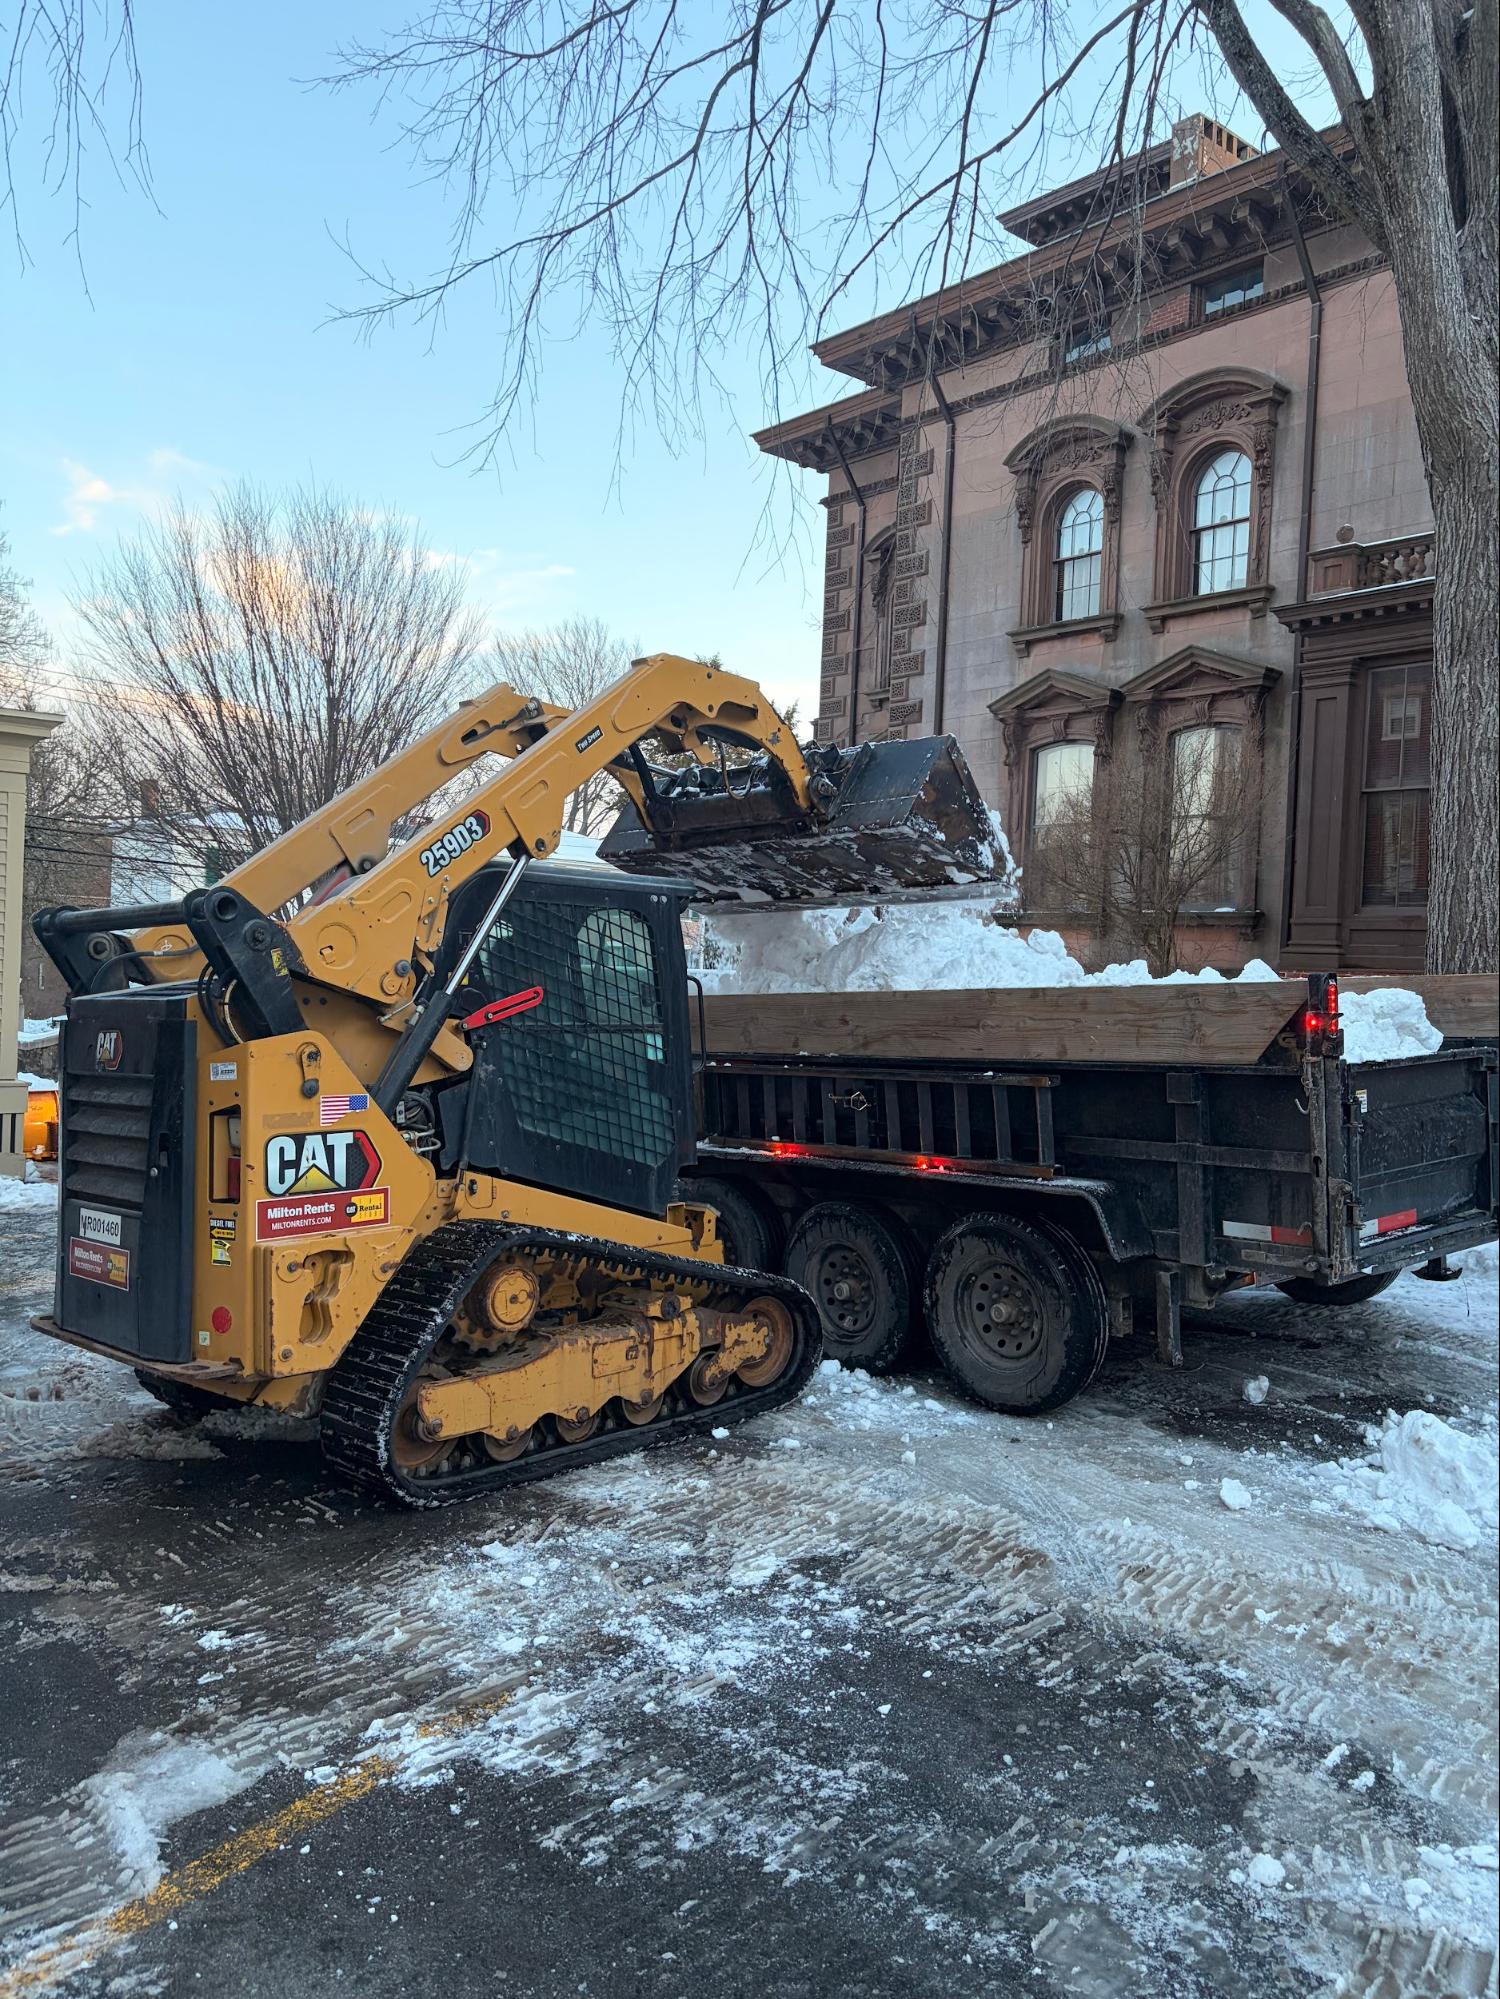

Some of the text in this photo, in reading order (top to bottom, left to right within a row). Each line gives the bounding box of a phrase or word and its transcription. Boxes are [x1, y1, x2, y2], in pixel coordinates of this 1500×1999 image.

[420, 816, 483, 877] 259D3
[96, 1032, 117, 1060] CAT
[267, 1131, 354, 1195] CAT
[267, 1202, 336, 1220] Milton Rents
[359, 1203, 382, 1212] Rental
[271, 1216, 332, 1231] MILTONRENTS.COM
